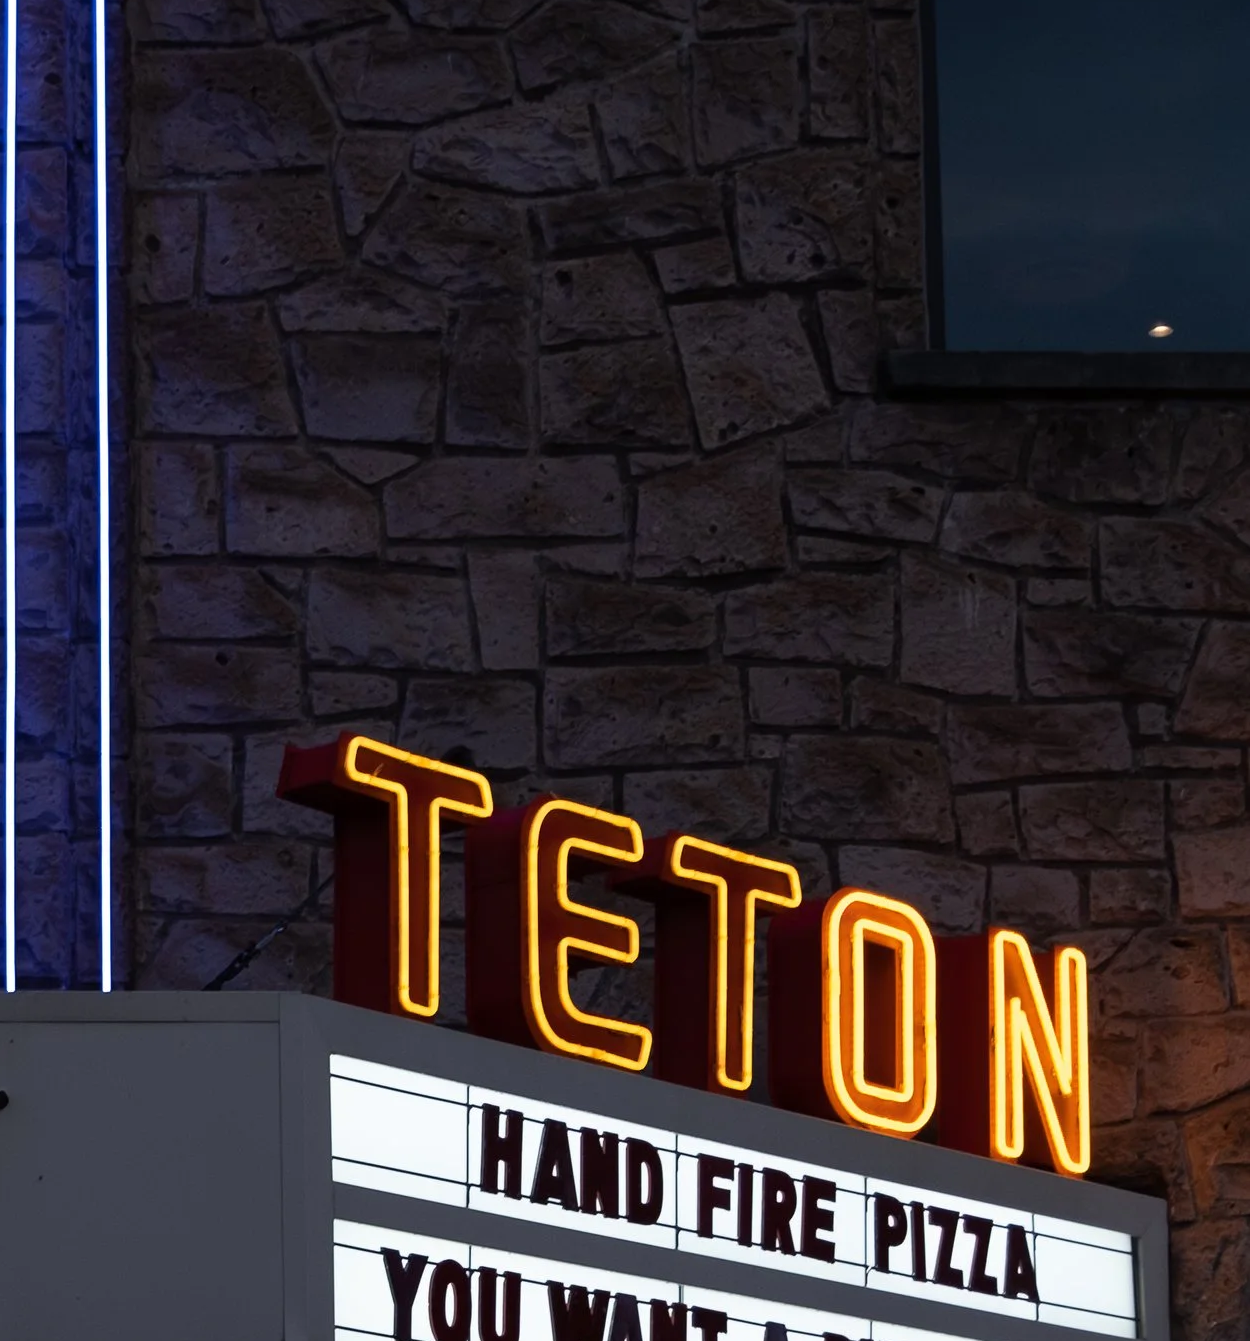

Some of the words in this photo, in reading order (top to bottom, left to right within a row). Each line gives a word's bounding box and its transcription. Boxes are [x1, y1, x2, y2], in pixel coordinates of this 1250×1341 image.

[345, 734, 1092, 1177] TETON
[479, 1103, 664, 1226] HAND
[696, 1153, 837, 1263] FIRE
[871, 1191, 1040, 1304] PIZZA
